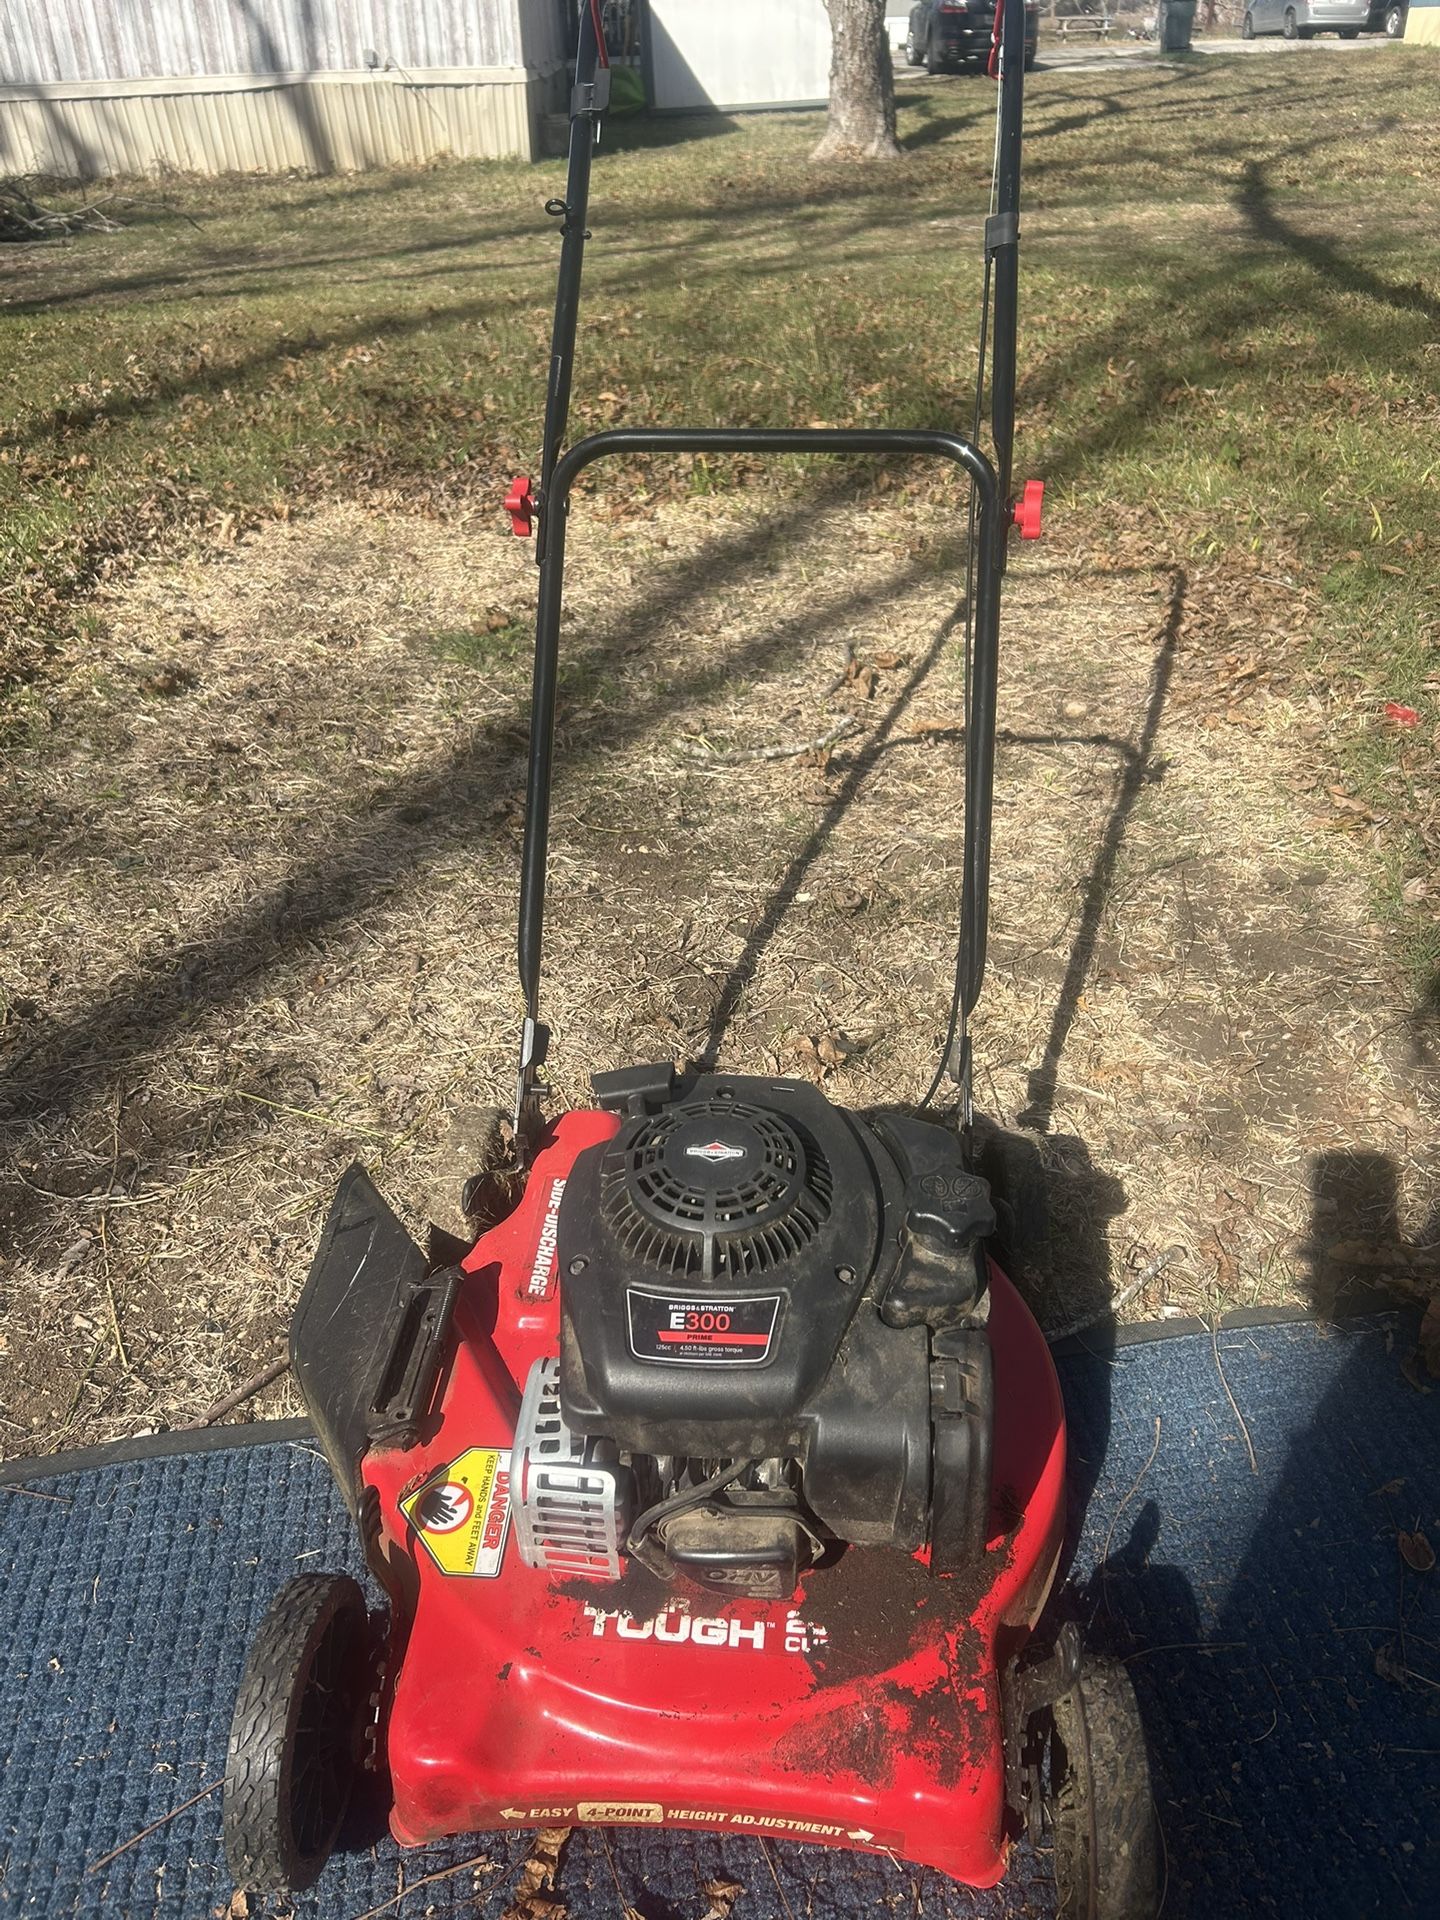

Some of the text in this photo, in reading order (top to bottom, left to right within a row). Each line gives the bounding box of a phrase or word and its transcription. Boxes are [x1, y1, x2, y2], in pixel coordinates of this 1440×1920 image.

[669, 1312, 731, 1331] E300
[465, 1454, 495, 1567] KEEP HANDS and FEET AWAY
[482, 1471, 511, 1550] DANGER
[584, 1606, 765, 1649] TOUGH
[529, 1806, 846, 1837] EASY 4-POINT HEIGHT ADJUSTMENT
